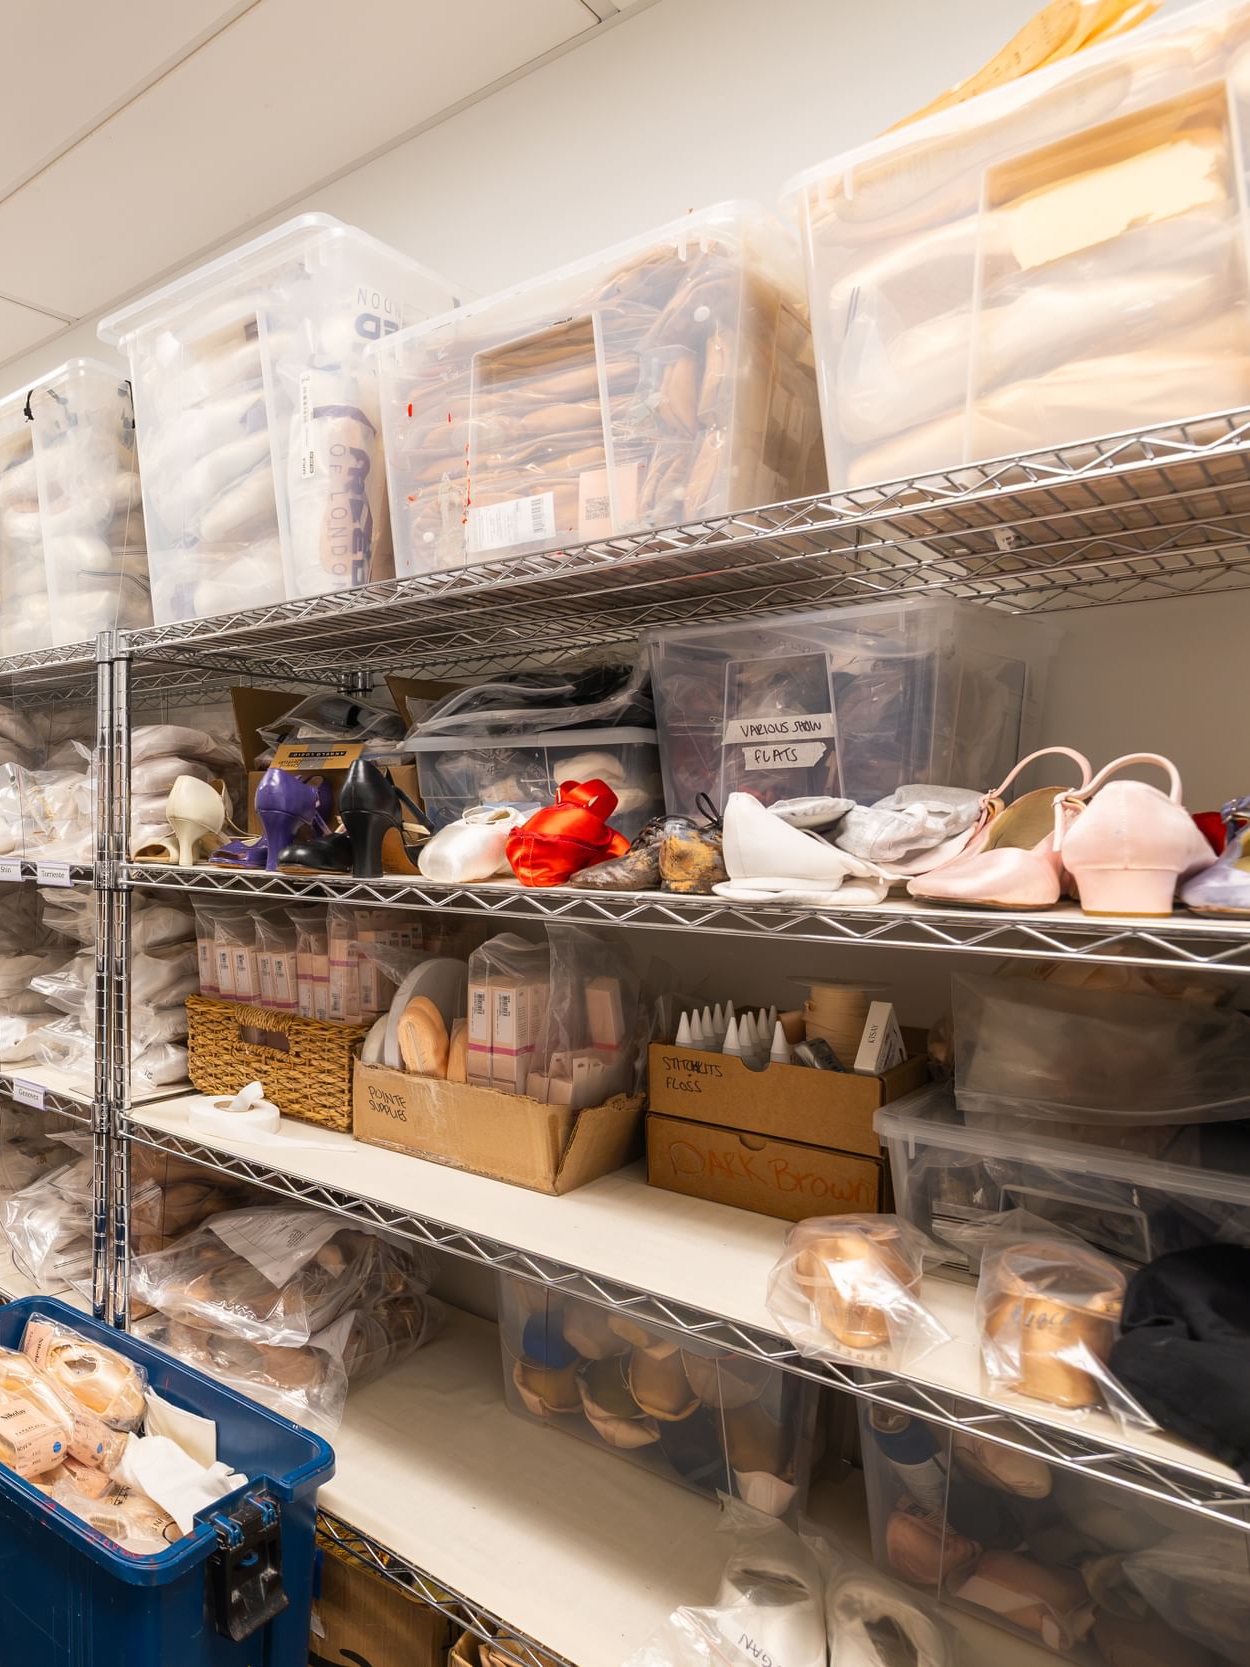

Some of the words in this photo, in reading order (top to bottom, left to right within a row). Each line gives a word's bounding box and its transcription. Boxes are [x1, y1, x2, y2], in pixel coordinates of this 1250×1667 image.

[740, 722, 789, 738] VARIOUS
[754, 747, 798, 764] FLATS
[666, 1077, 702, 1093] FLOSS
[368, 1085, 406, 1109] POINTE
[369, 1099, 407, 1122] SUPPLIES
[669, 1140, 768, 1186] DARK
[768, 1158, 877, 1206] Brown
